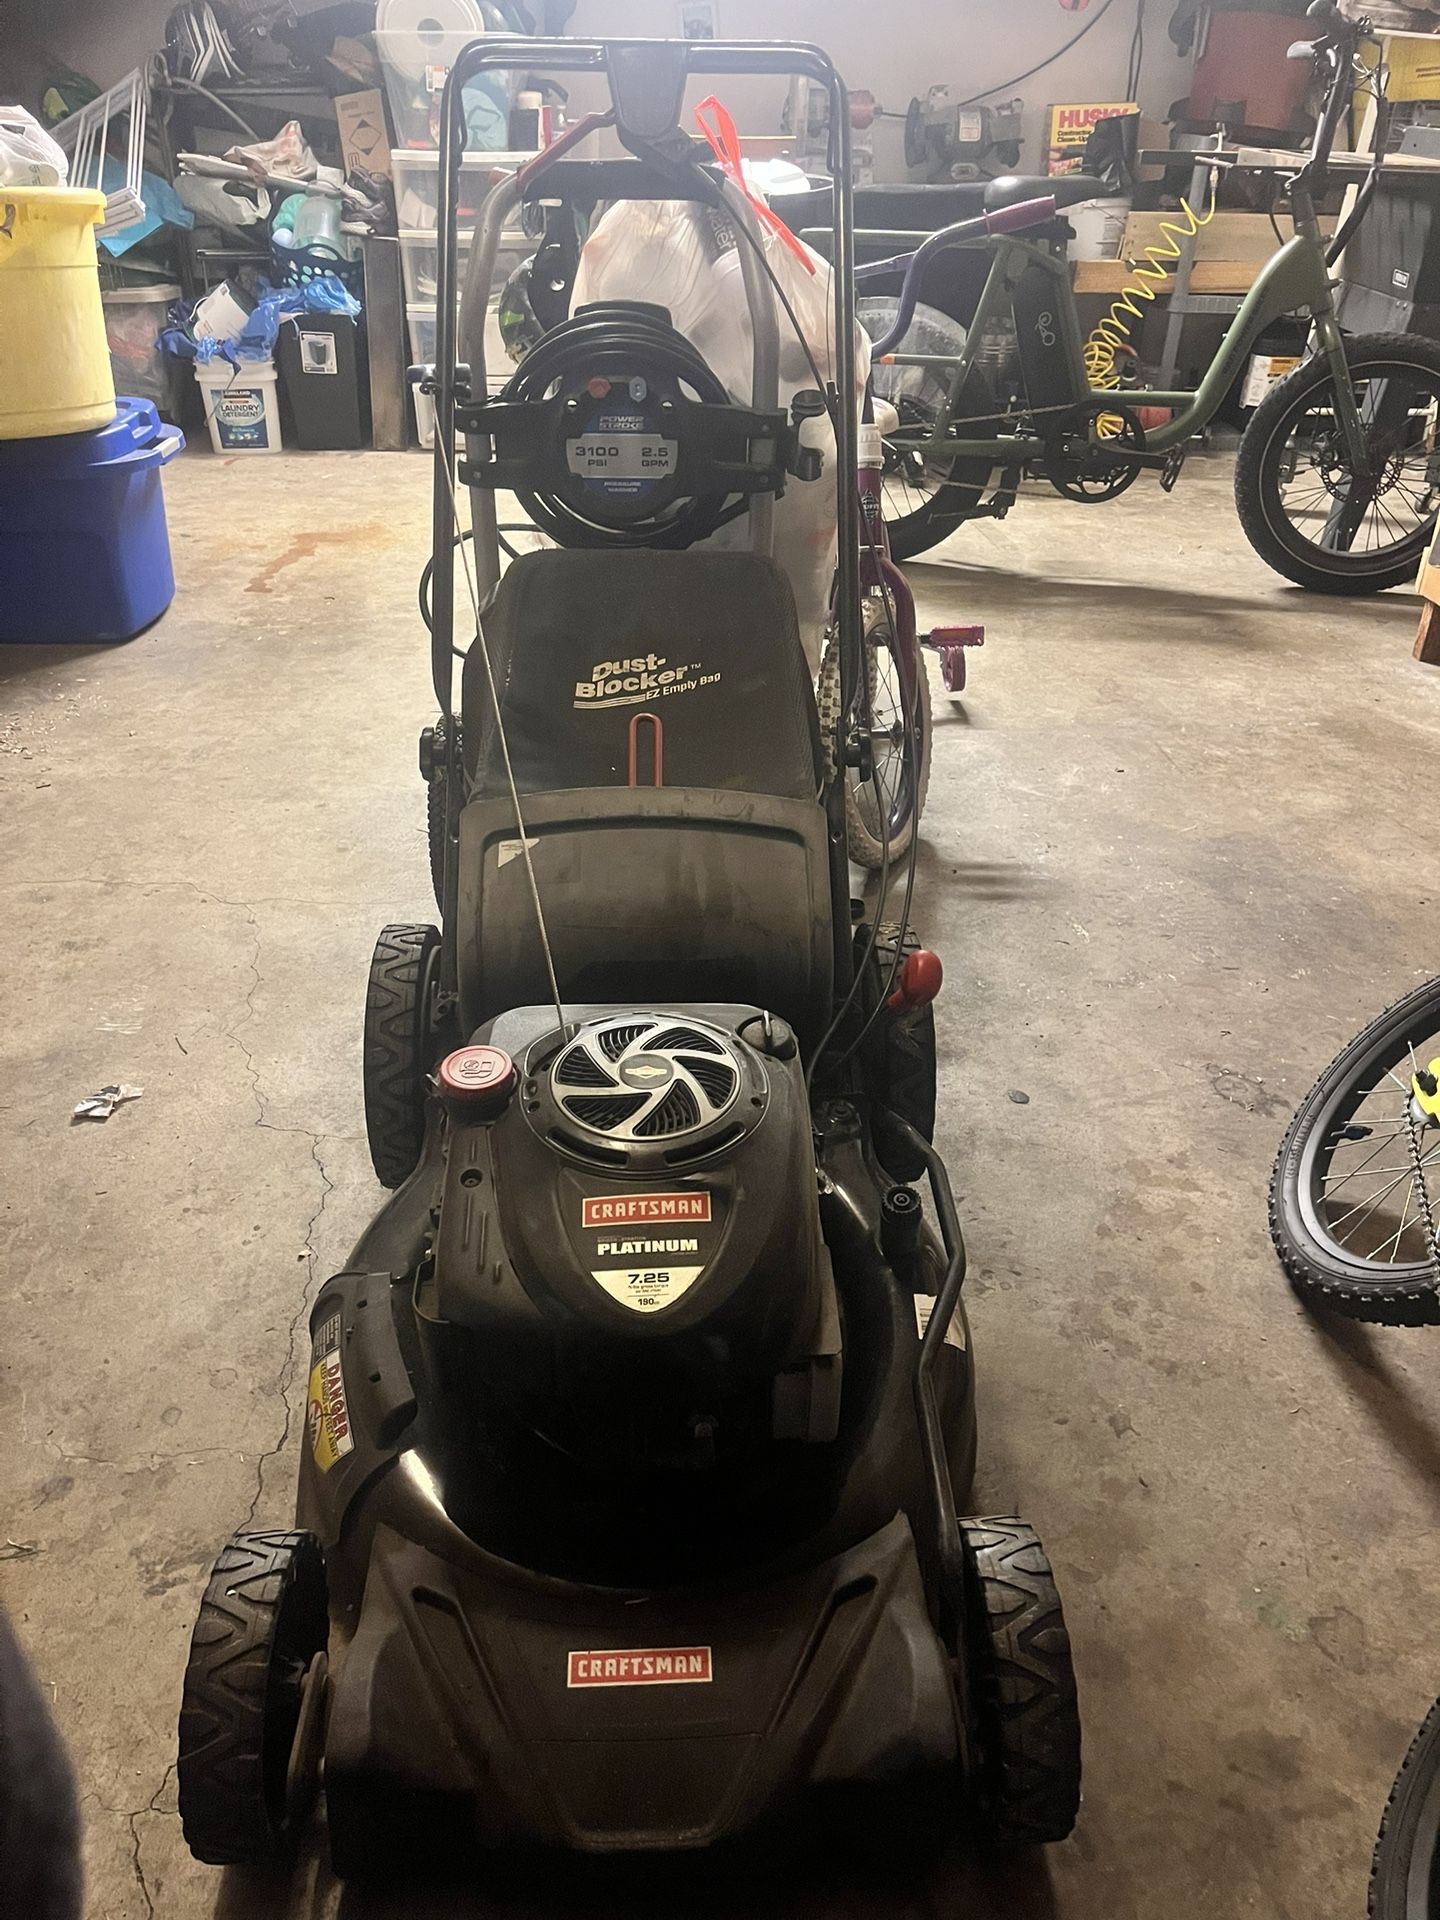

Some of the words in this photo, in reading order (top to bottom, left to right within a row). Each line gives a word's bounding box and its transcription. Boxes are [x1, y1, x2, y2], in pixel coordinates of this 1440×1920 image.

[599, 423, 644, 431] STROKE
[575, 446, 619, 457] 3100
[641, 447, 669, 457] 2.5
[587, 459, 608, 467] PSI
[641, 460, 669, 468] GPM
[591, 653, 667, 683] Dust-
[575, 665, 688, 698] Blocker
[646, 689, 660, 700] EZ
[662, 680, 698, 696] Empty
[699, 672, 722, 686] Bag
[591, 1199, 703, 1219] CRAFTSMAN
[597, 1239, 698, 1256] PLATINUM
[628, 1272, 670, 1285] 7.25
[327, 1362, 348, 1441] DANGER
[577, 1655, 703, 1677] CRAFTSMAN
